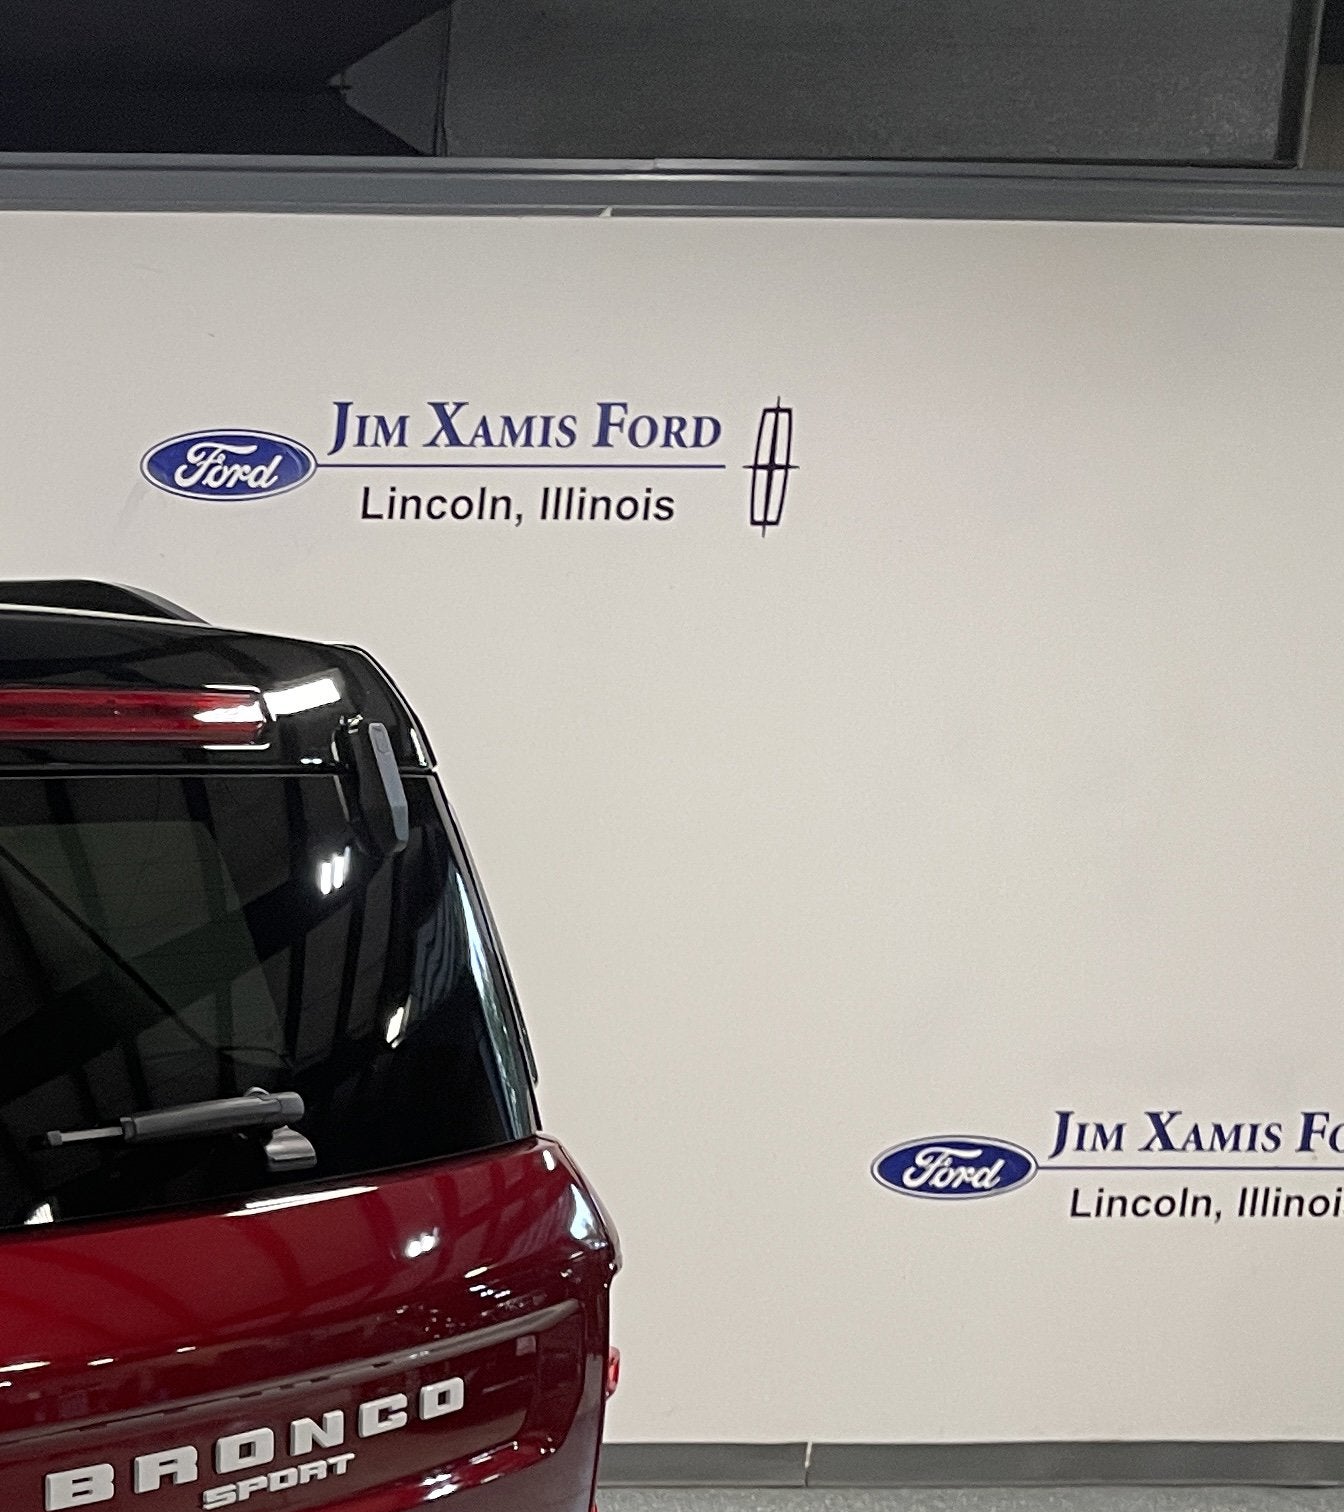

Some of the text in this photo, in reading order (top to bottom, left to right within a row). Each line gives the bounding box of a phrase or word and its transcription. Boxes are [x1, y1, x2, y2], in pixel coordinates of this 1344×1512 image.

[326, 401, 722, 457] JIM XAMIS FORD
[360, 486, 675, 527] Lincoln, Illinois
[1047, 1111, 1127, 1160] JIM
[1137, 1110, 1283, 1154] XAMIS
[1069, 1186, 1344, 1224] Lincoln, Illinoi
[44, 1376, 465, 1512] BRONCO
[202, 1452, 356, 1511] SPORT
